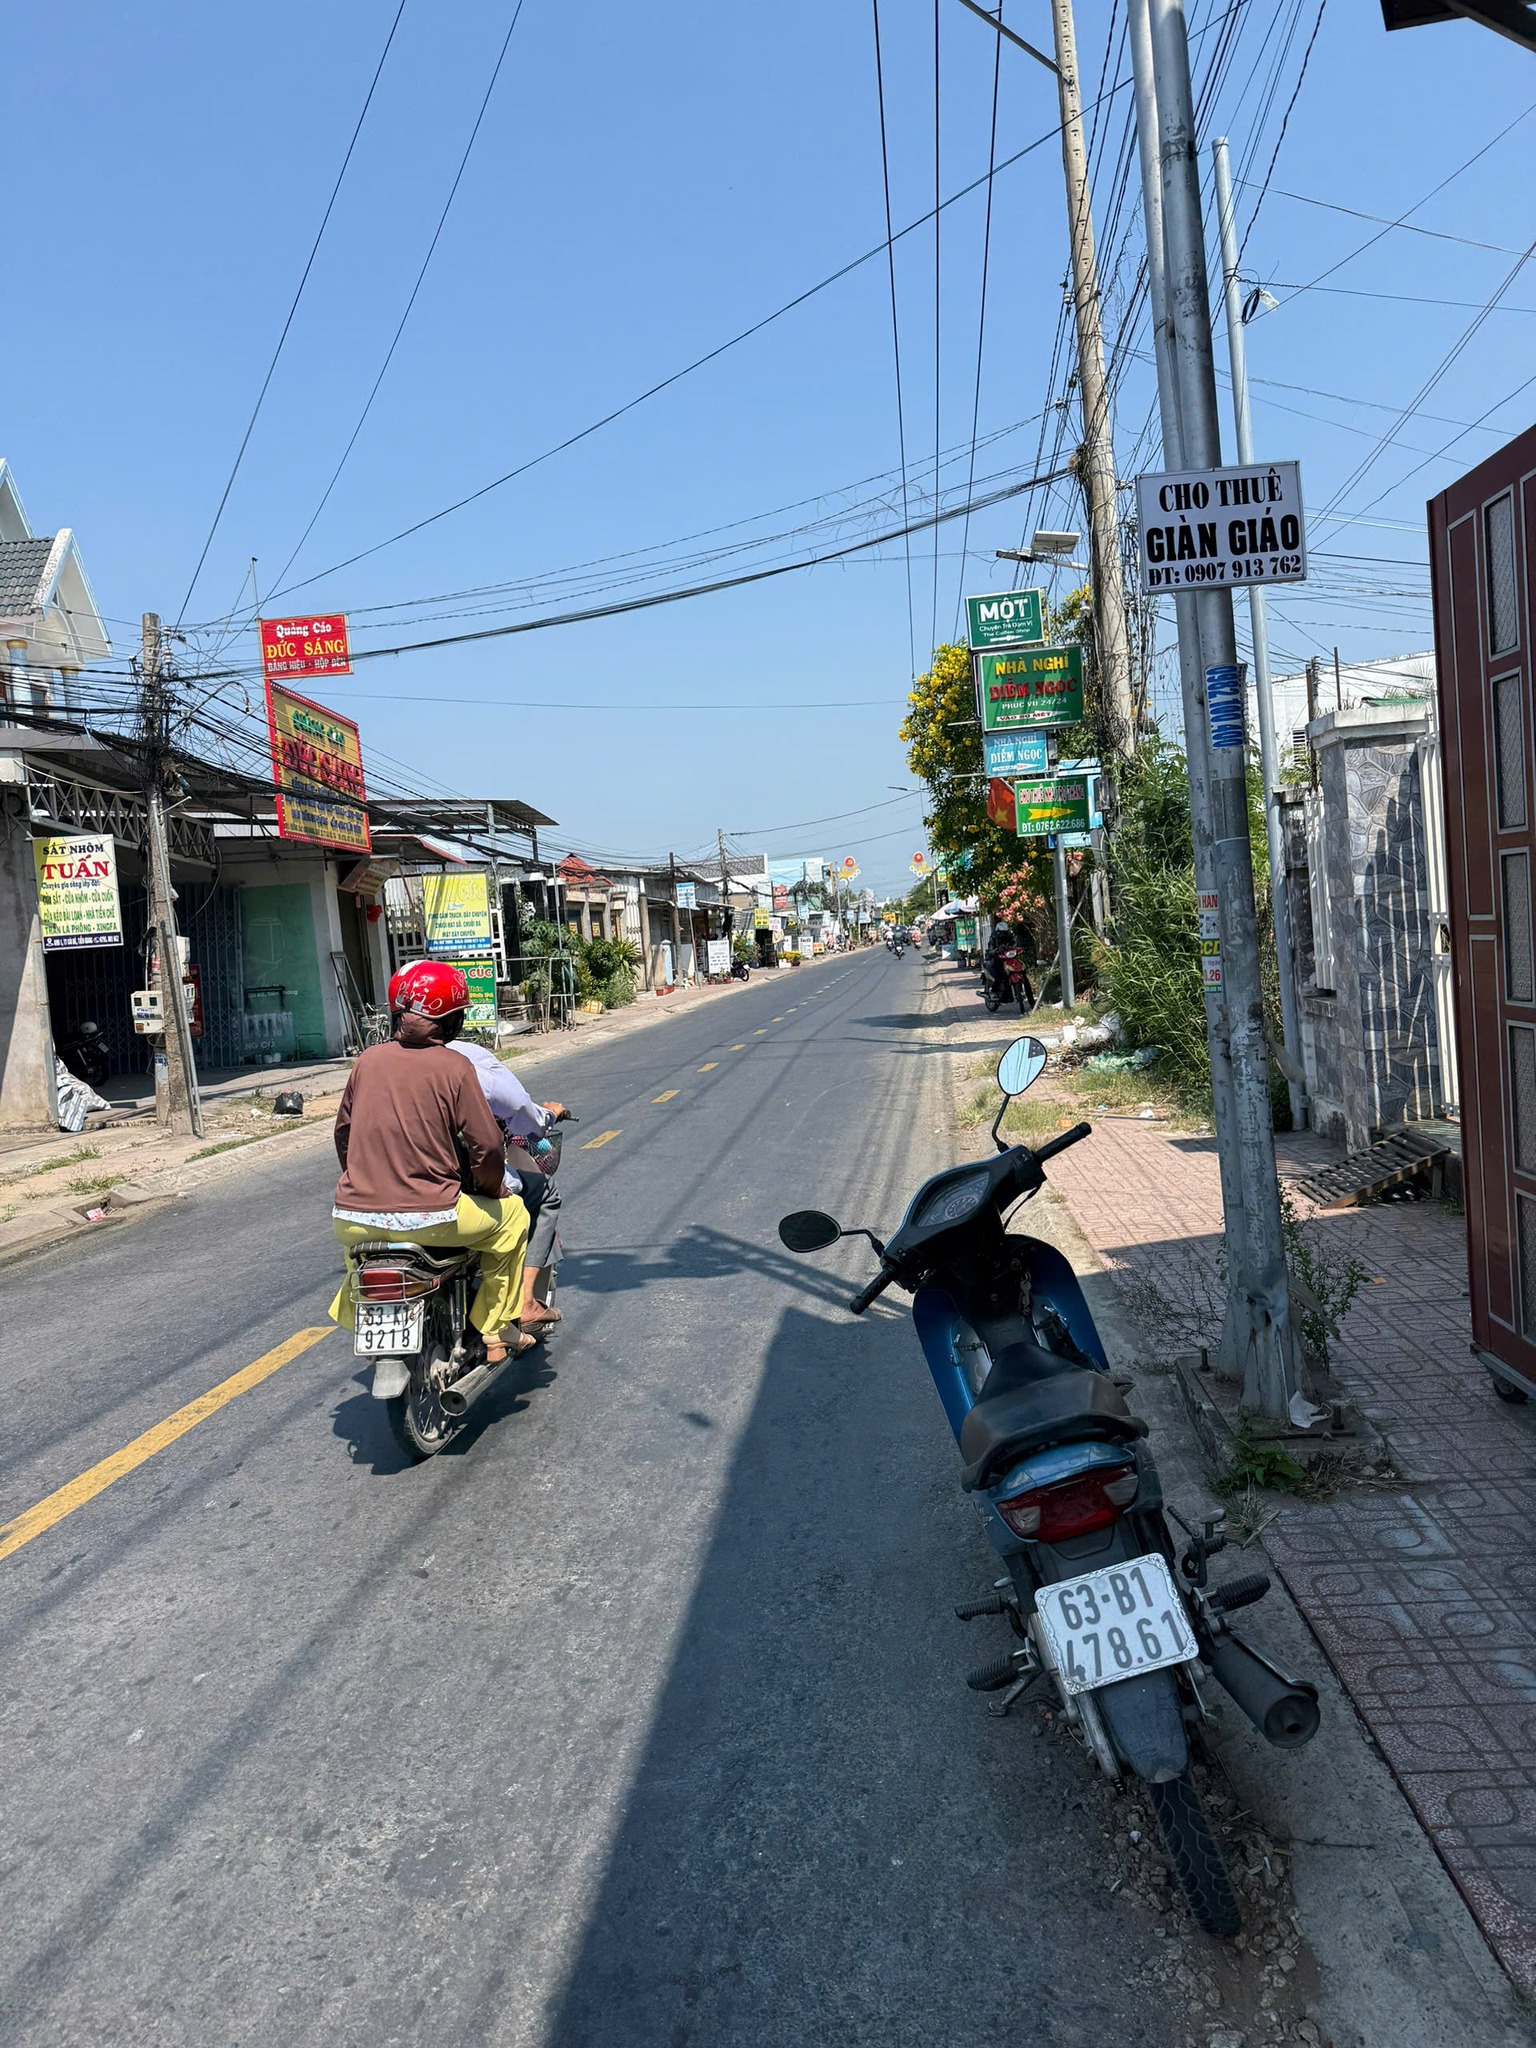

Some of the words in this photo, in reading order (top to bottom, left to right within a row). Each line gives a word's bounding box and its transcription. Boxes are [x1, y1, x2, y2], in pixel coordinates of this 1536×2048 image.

[1159, 482, 1209, 512] CHO
[1215, 468, 1283, 507] THUÊ
[1146, 515, 1218, 563] GIÀN
[1228, 507, 1300, 556] GIÁO
[1148, 567, 1180, 586] ĐT:
[1185, 562, 1227, 583] 0907
[1231, 558, 1264, 578] 913
[1270, 555, 1301, 576] 762
[980, 597, 1028, 622] MỘT
[276, 622, 309, 638] Quảng
[312, 621, 332, 634] Cáo
[266, 639, 297, 658] ĐỨC
[304, 637, 345, 656] SÁNG
[994, 657, 1027, 676] NHÀ
[1032, 651, 1069, 672] NGHỈ
[1035, 678, 1077, 698] NGỌC
[994, 735, 1013, 747] NHÀ
[1015, 732, 1037, 745] NGHỈ
[1017, 749, 1042, 762] NGỌC
[1021, 822, 1035, 832] ĐT:
[1035, 819, 1085, 831] 0762.622.686
[42, 842, 66, 855] SẮT
[69, 842, 104, 854] NHÔM
[40, 854, 109, 880] TUẤN
[468, 966, 493, 979] CÚC
[365, 1328, 410, 1350] 9218
[1058, 1566, 1154, 1630] 63-B1
[1066, 1610, 1186, 1682] 478.61
